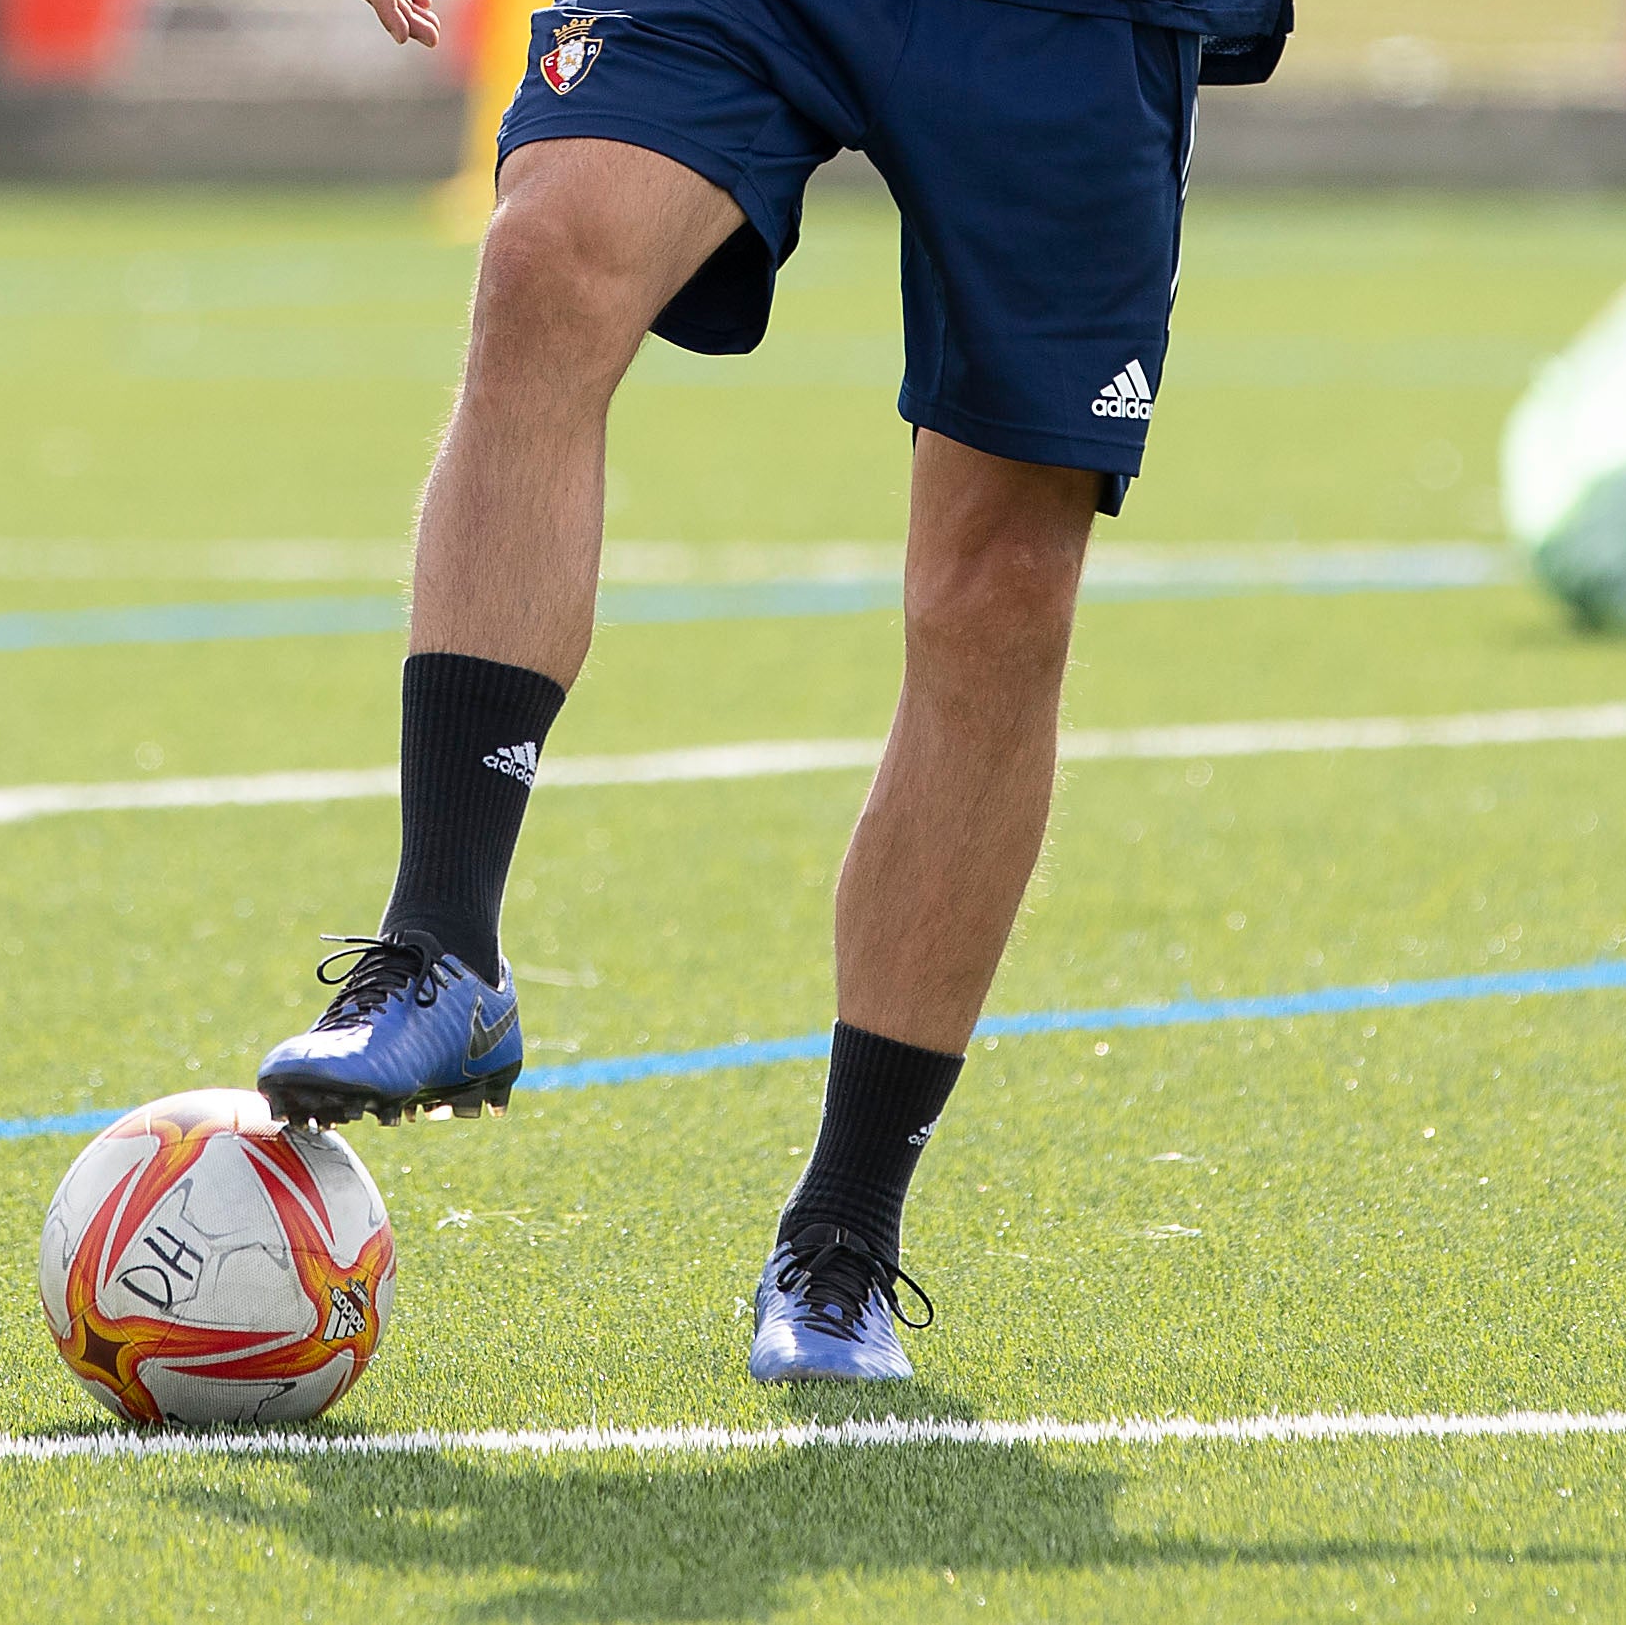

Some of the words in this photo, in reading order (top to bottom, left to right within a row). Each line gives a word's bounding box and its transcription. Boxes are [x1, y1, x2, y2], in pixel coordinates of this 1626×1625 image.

[482, 754, 534, 787] adida
[115, 1226, 204, 1311] DH
[331, 1287, 366, 1332] adidas
